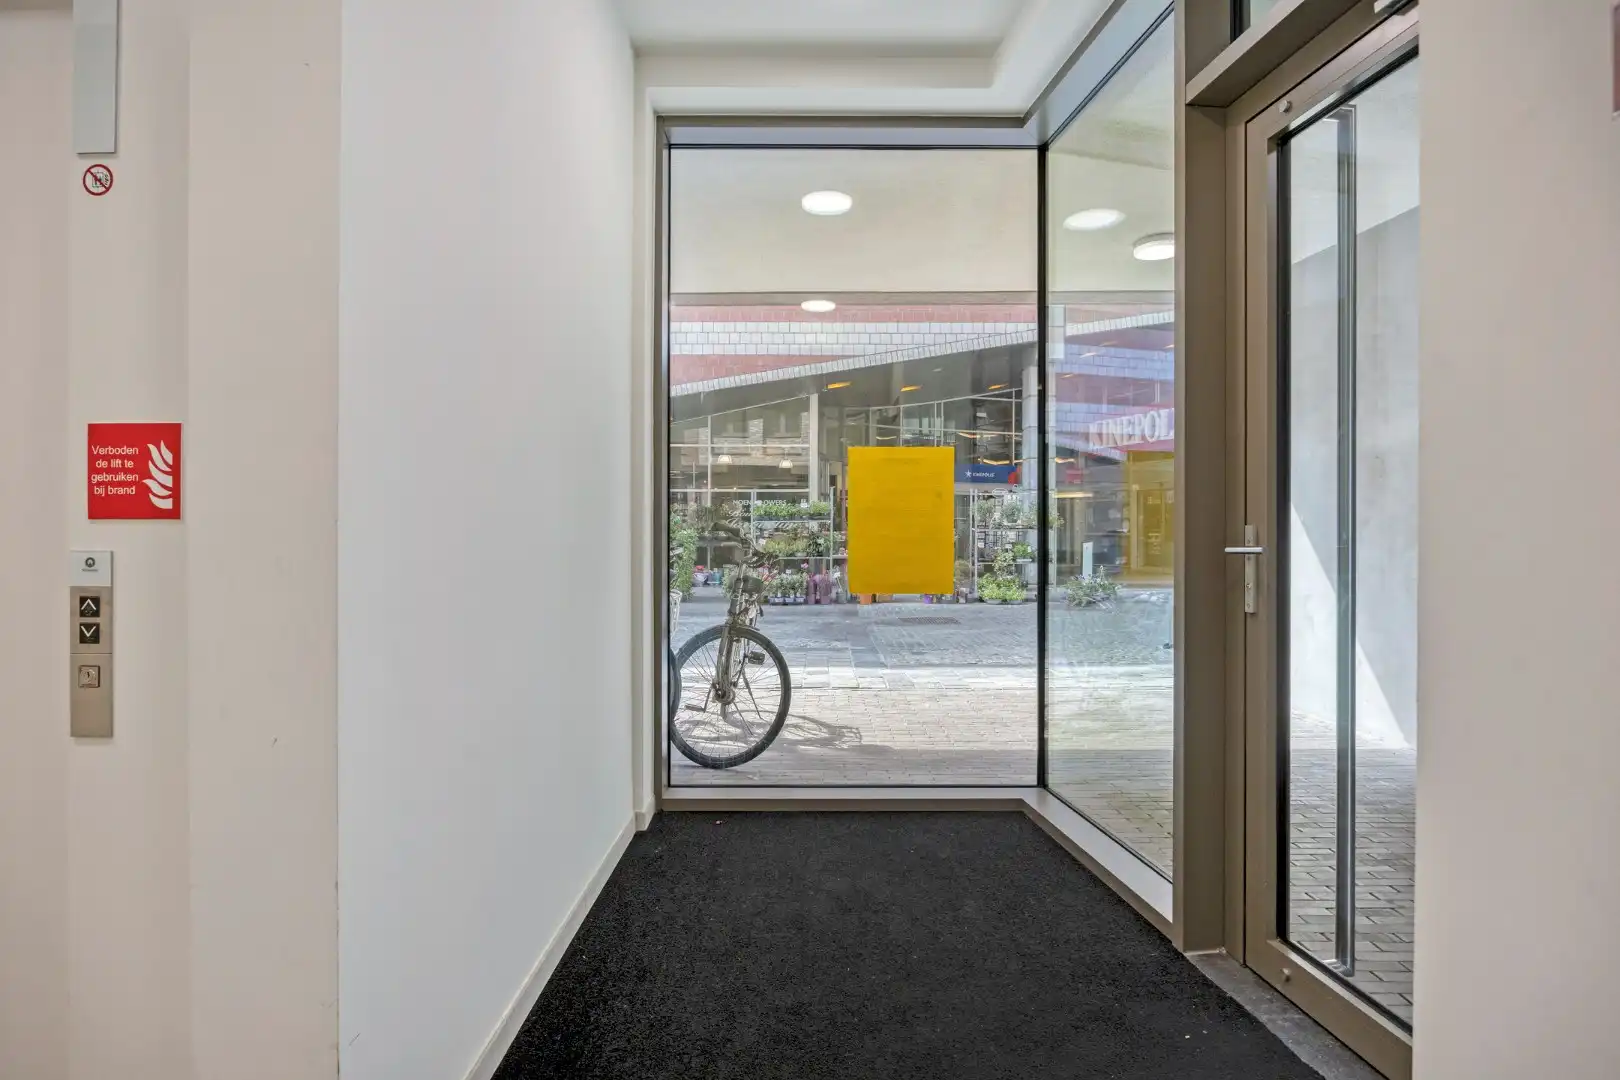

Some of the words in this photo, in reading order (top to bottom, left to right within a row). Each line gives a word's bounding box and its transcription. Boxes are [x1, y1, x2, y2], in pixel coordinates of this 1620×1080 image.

[91, 445, 139, 455] Verboden
[95, 459, 108, 468] de
[110, 459, 122, 468] lift
[124, 459, 134, 468] te
[91, 472, 139, 484] gebruiken
[94, 485, 105, 497] bij
[107, 485, 136, 495] brand
